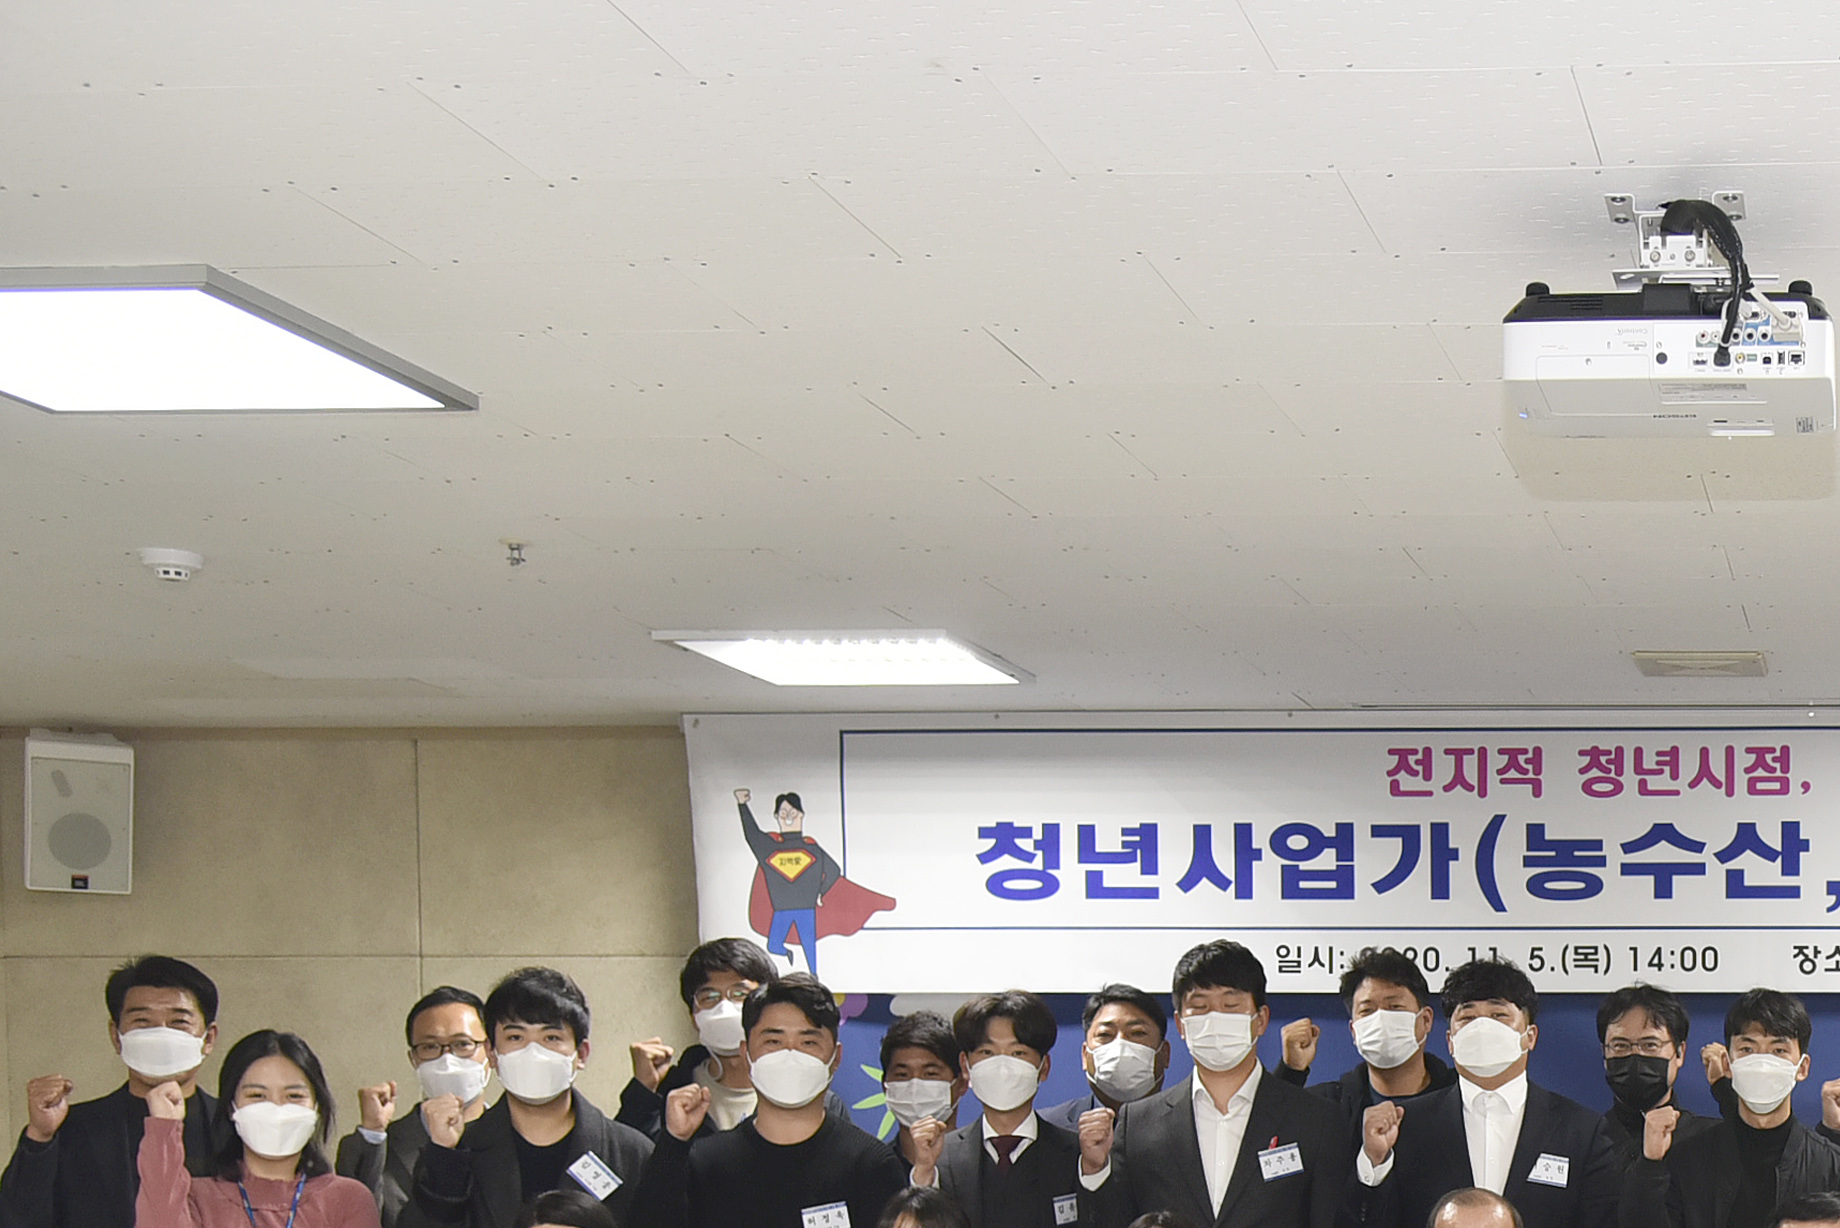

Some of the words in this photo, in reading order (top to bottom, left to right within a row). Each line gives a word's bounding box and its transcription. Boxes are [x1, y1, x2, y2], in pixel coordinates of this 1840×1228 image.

[1386, 745, 1542, 798] 전지적
[1578, 745, 1811, 798] 청년시점,
[1528, 943, 1612, 975] 5.(목)
[1629, 945, 1719, 973] 14:00
